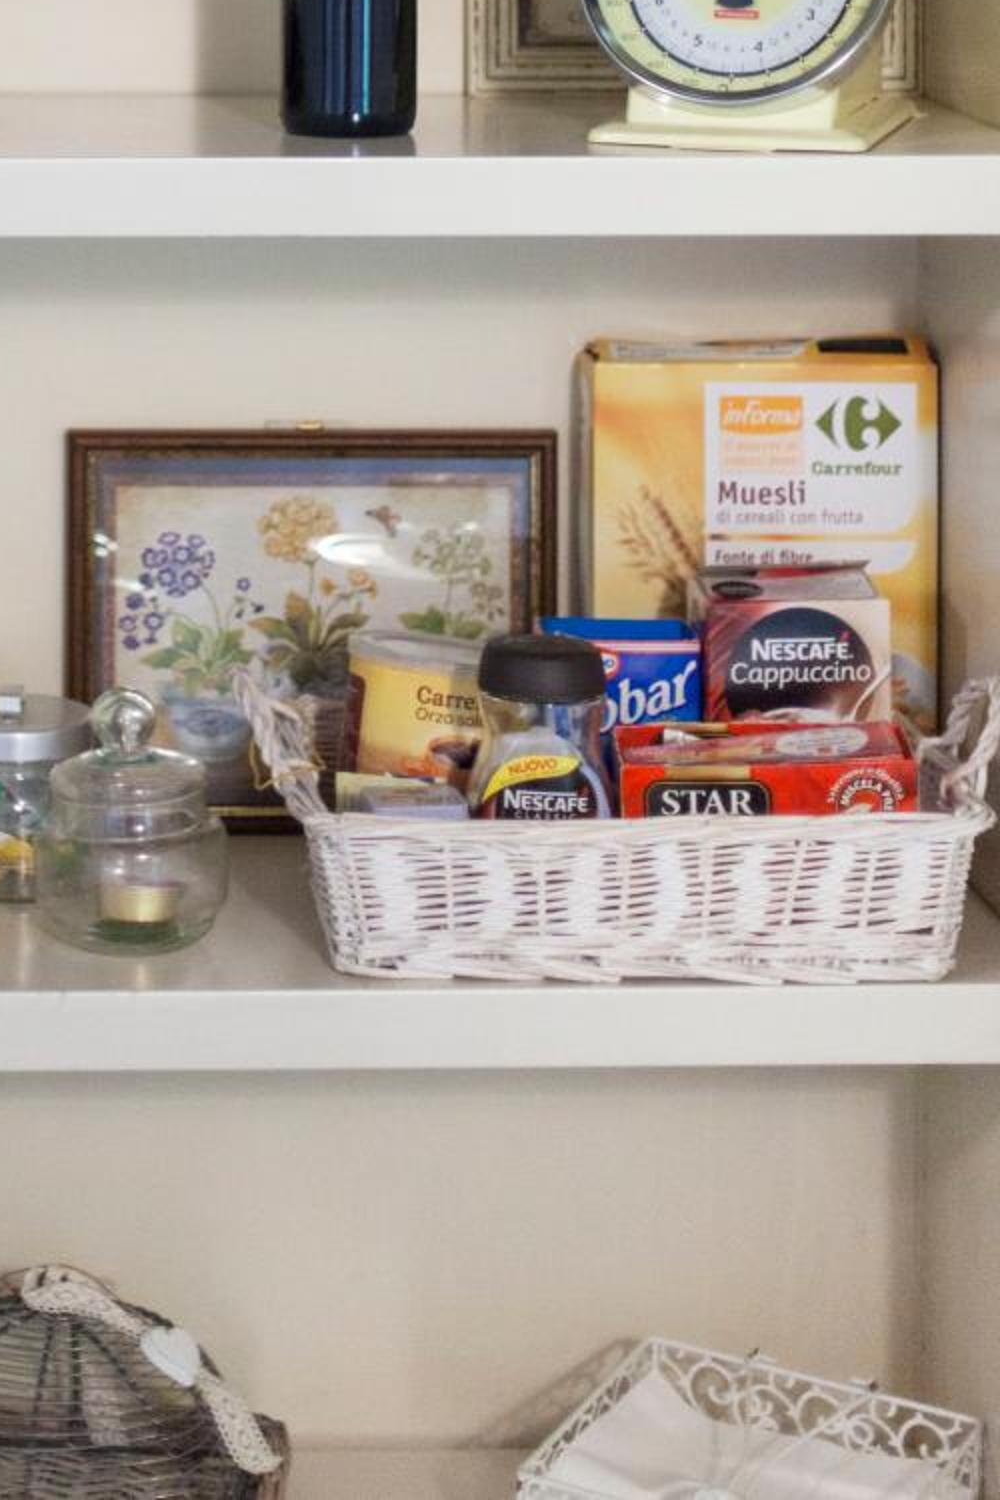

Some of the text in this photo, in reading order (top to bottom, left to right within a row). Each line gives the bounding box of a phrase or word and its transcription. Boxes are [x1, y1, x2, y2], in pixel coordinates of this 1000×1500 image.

[811, 461, 903, 476] Carrefour
[717, 479, 806, 506] Muesli
[716, 510, 864, 525] di cereali con frutta
[714, 549, 814, 565] Fonte di fibre
[729, 660, 872, 690] Cappuccino
[506, 757, 559, 774] NUOVO
[660, 788, 755, 816] STAR
